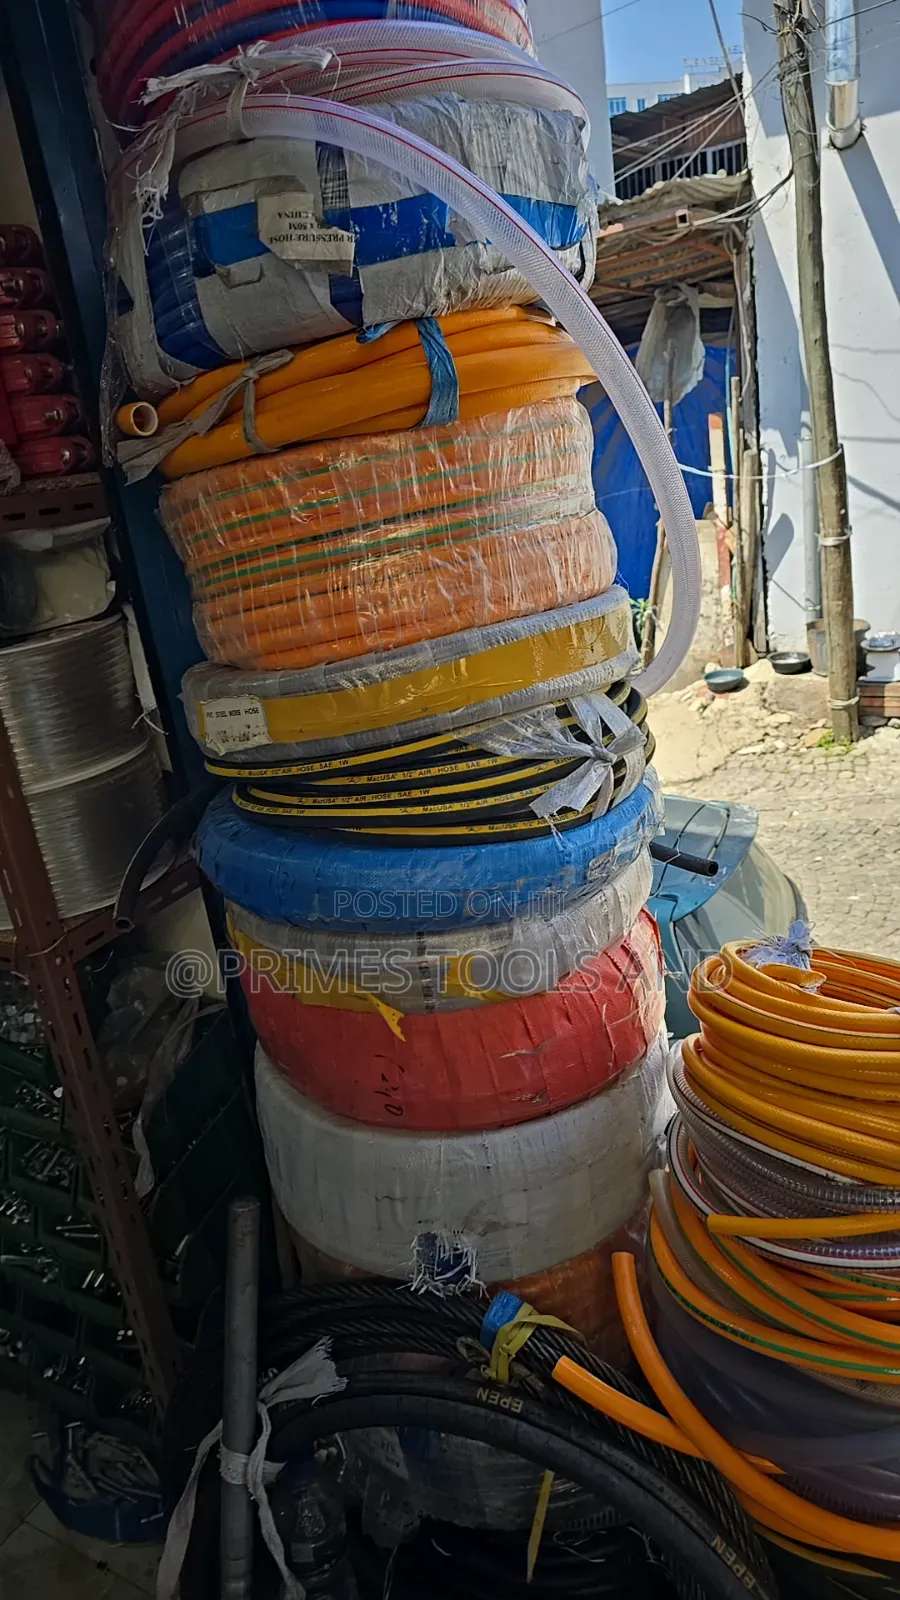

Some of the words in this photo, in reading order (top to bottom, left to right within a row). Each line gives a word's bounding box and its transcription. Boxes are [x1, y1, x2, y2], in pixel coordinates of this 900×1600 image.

[277, 211, 309, 219] CHINA
[437, 765, 460, 773] HOSE
[476, 1386, 524, 1414] EPEN
[711, 1534, 757, 1590] EPEN
